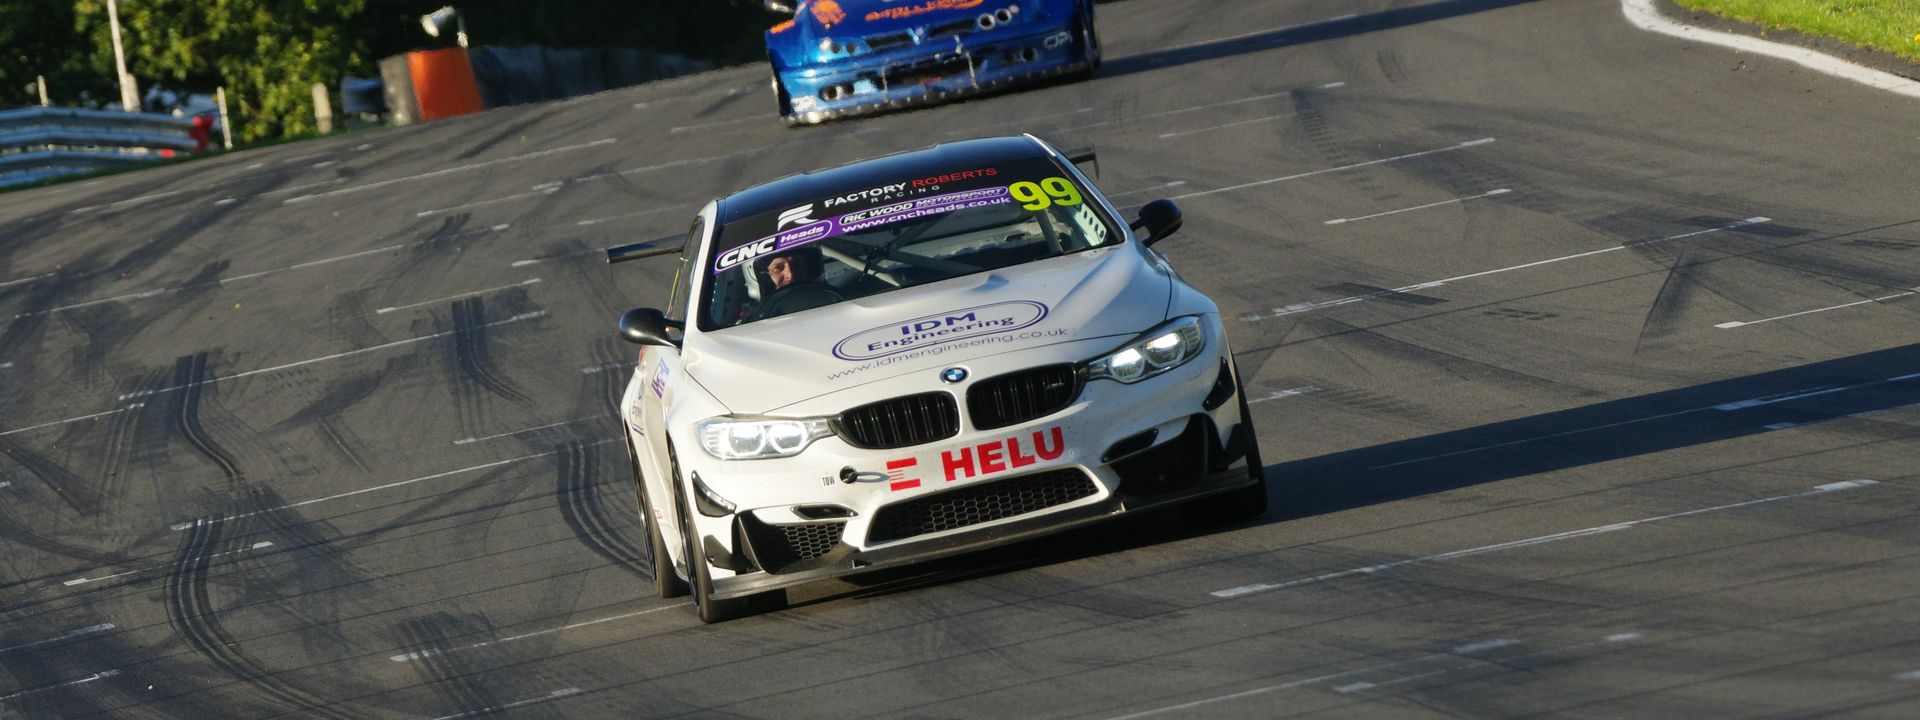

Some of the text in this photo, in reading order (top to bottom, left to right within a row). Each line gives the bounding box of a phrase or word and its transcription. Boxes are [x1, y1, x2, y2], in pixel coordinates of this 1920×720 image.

[824, 168, 998, 208] FACTORY ROBERTS
[843, 188, 1002, 224] RIC WOOD MOTORSPORT
[871, 185, 940, 203] RACING
[1009, 177, 1082, 211] 99
[842, 197, 1011, 233] www.cncheads.co.uk
[720, 225, 825, 268] CNC Heads
[867, 317, 1016, 352] Engineering
[901, 312, 977, 336] IDM
[827, 328, 1068, 381] www.idmengineering.co.uk
[941, 426, 1066, 482] HELU
